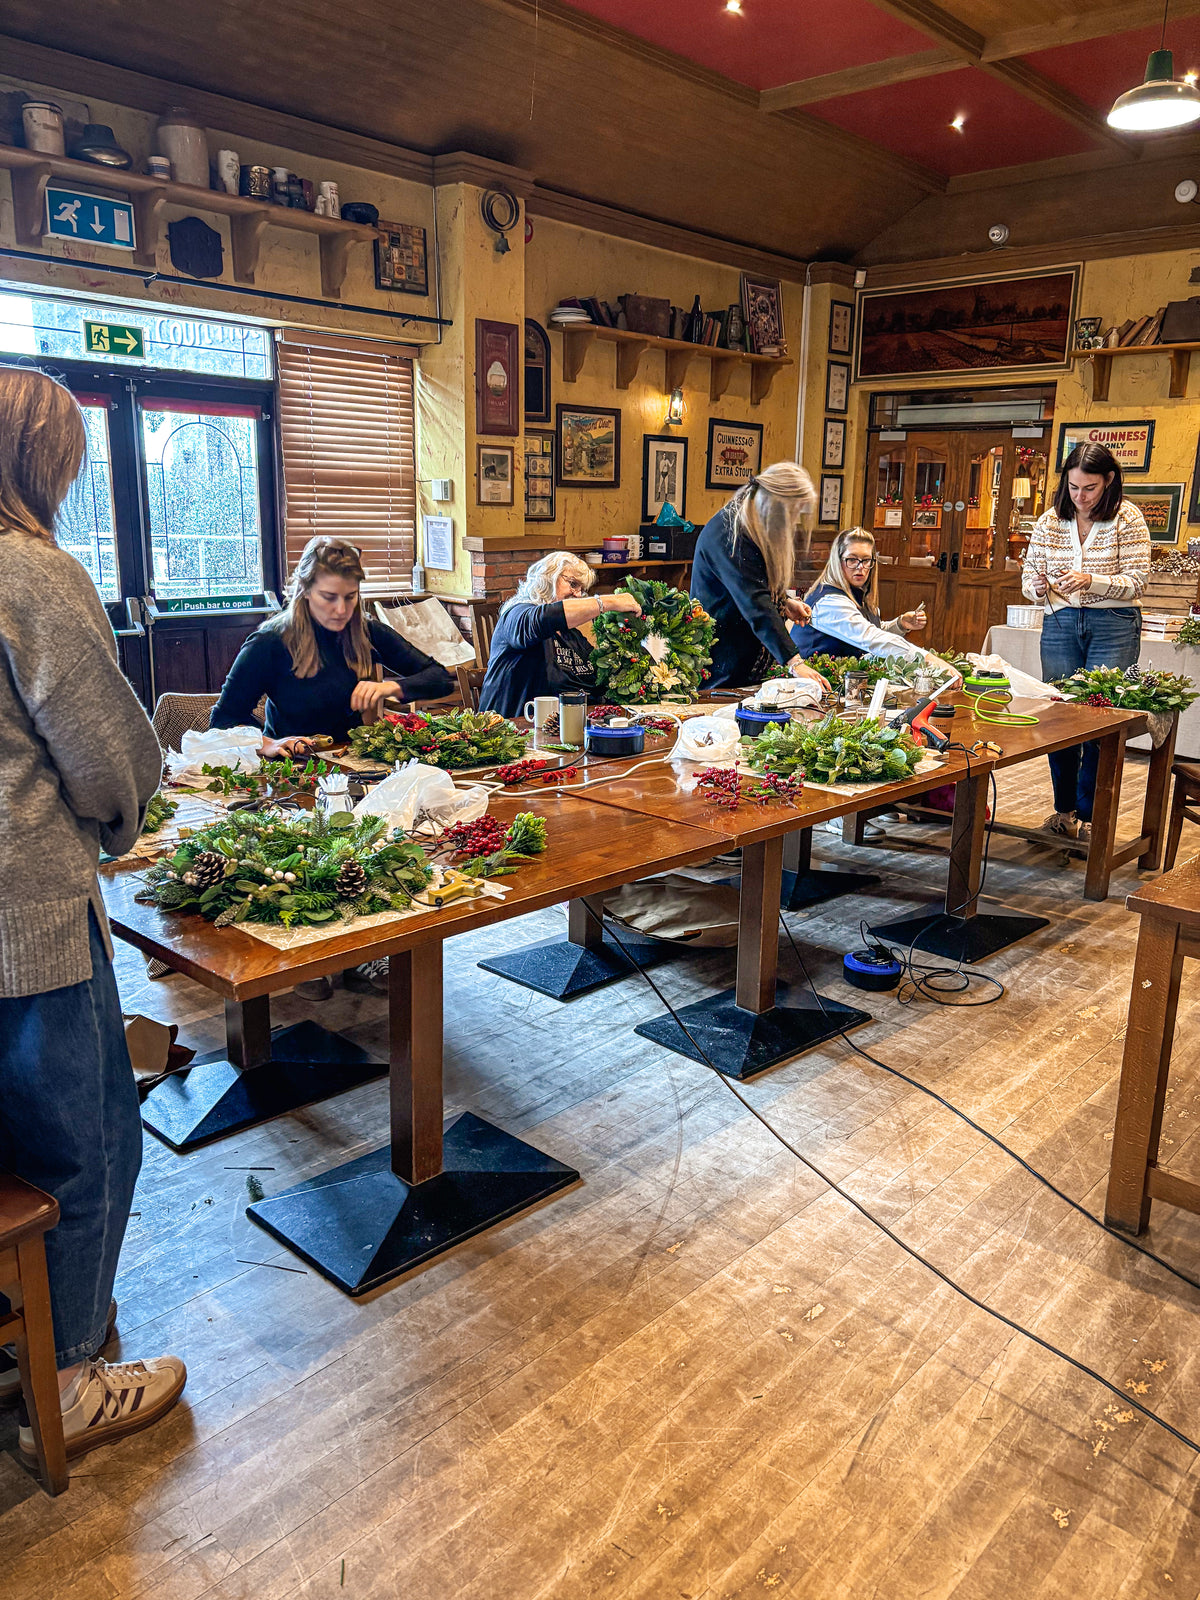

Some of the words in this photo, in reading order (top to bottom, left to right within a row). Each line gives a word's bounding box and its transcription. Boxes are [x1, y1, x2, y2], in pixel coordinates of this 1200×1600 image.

[1089, 429, 1146, 442] GUINNESS
[715, 464, 734, 477] EXTRA
[184, 602, 205, 610] Push
